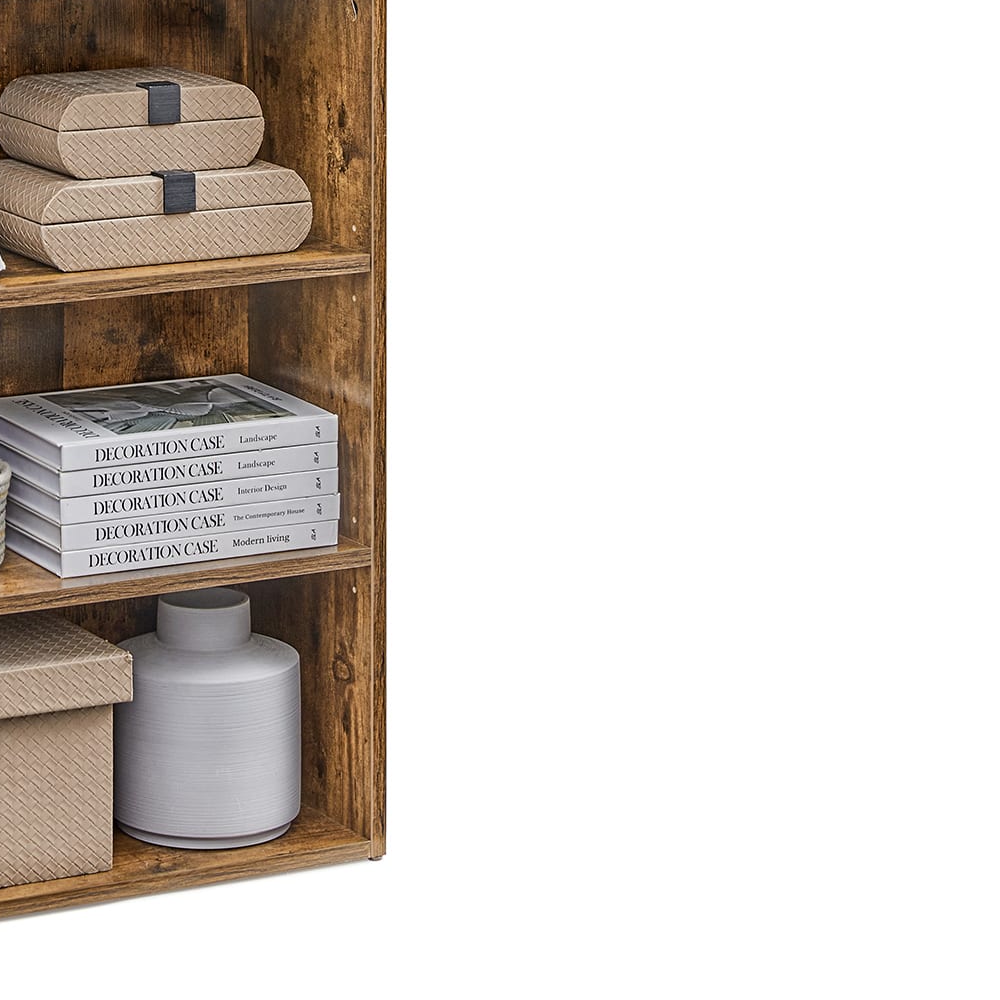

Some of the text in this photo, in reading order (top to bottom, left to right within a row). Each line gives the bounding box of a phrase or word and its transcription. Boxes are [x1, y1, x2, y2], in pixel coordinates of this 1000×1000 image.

[95, 435, 225, 462] DECORATION CASE
[239, 433, 278, 444] Landscape
[93, 461, 223, 488] DECORATION CASE
[238, 459, 276, 470] Landscape
[237, 483, 287, 495] Interior Design
[93, 487, 224, 515] DECORATION CASE
[245, 510, 285, 520] Contemporary
[286, 507, 305, 515] House
[95, 513, 226, 541] DECORATION CASE
[232, 533, 290, 548] Modern living
[89, 539, 219, 568] DECORATION CASE
